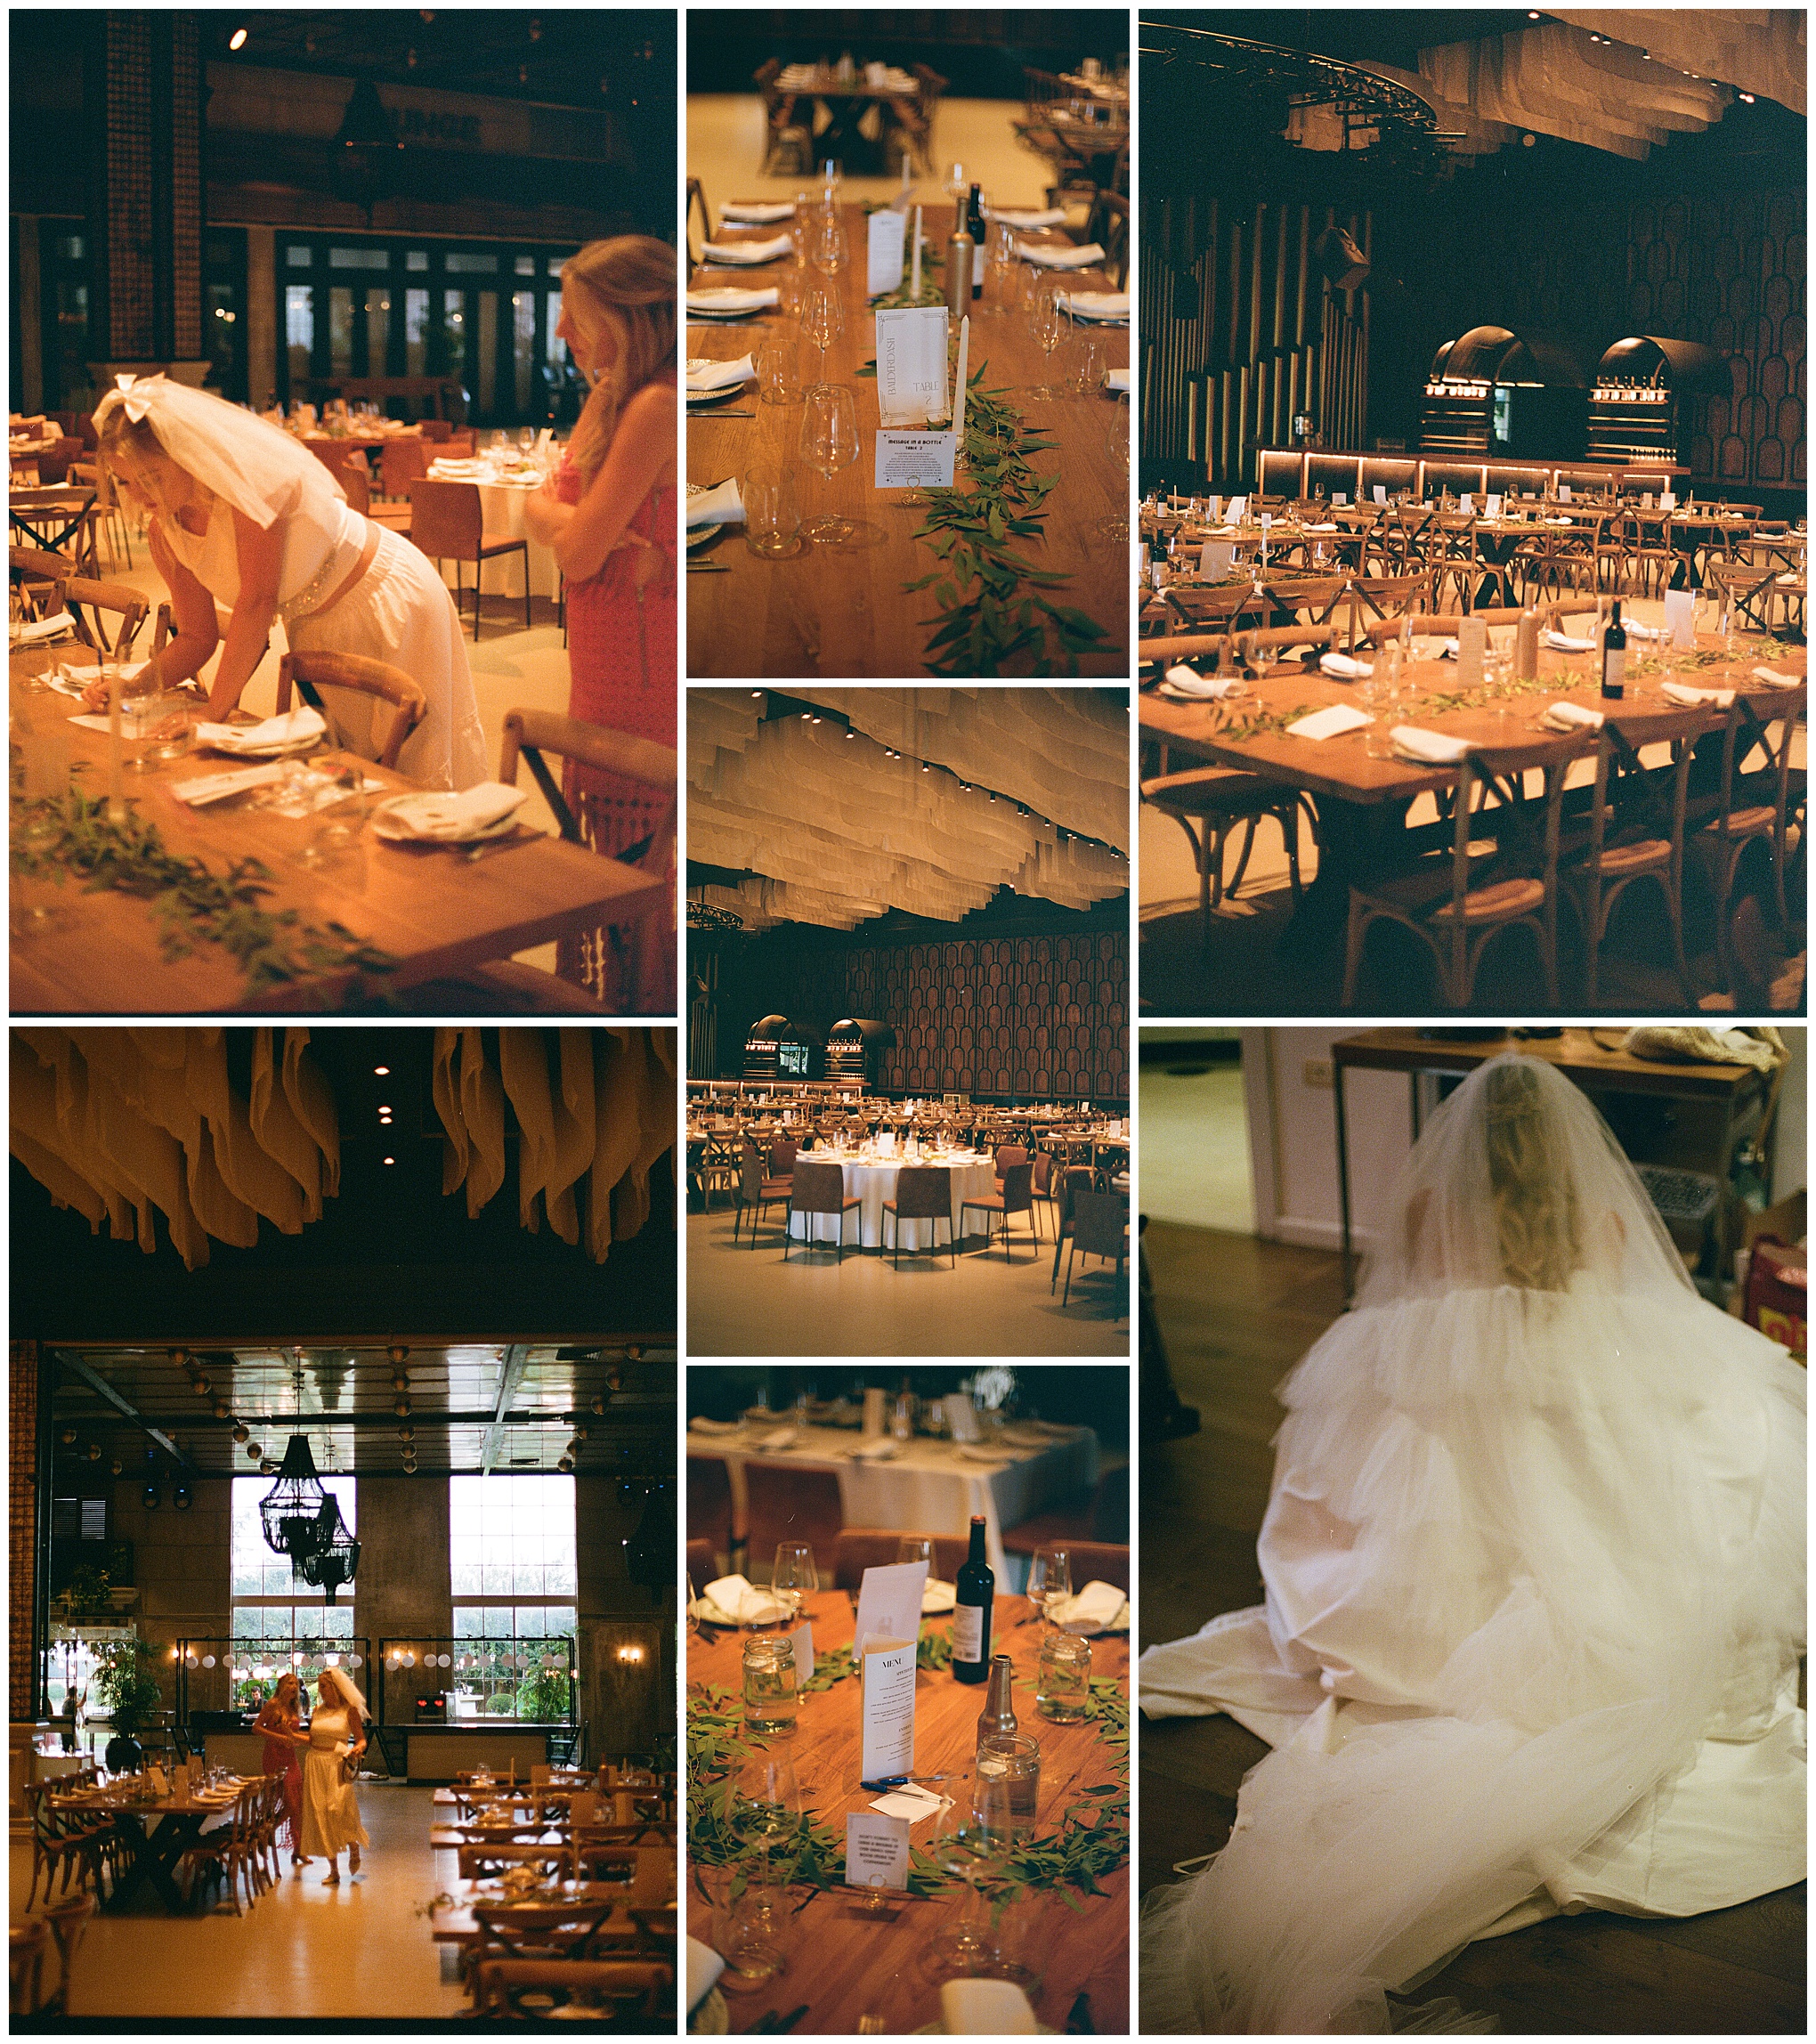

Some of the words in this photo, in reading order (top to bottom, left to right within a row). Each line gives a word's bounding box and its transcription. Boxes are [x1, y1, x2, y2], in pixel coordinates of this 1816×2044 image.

[887, 337, 896, 395] BALDERDASH
[913, 381, 939, 393] TABLE
[925, 395, 932, 405] 2
[882, 1657, 904, 1669] MENU
